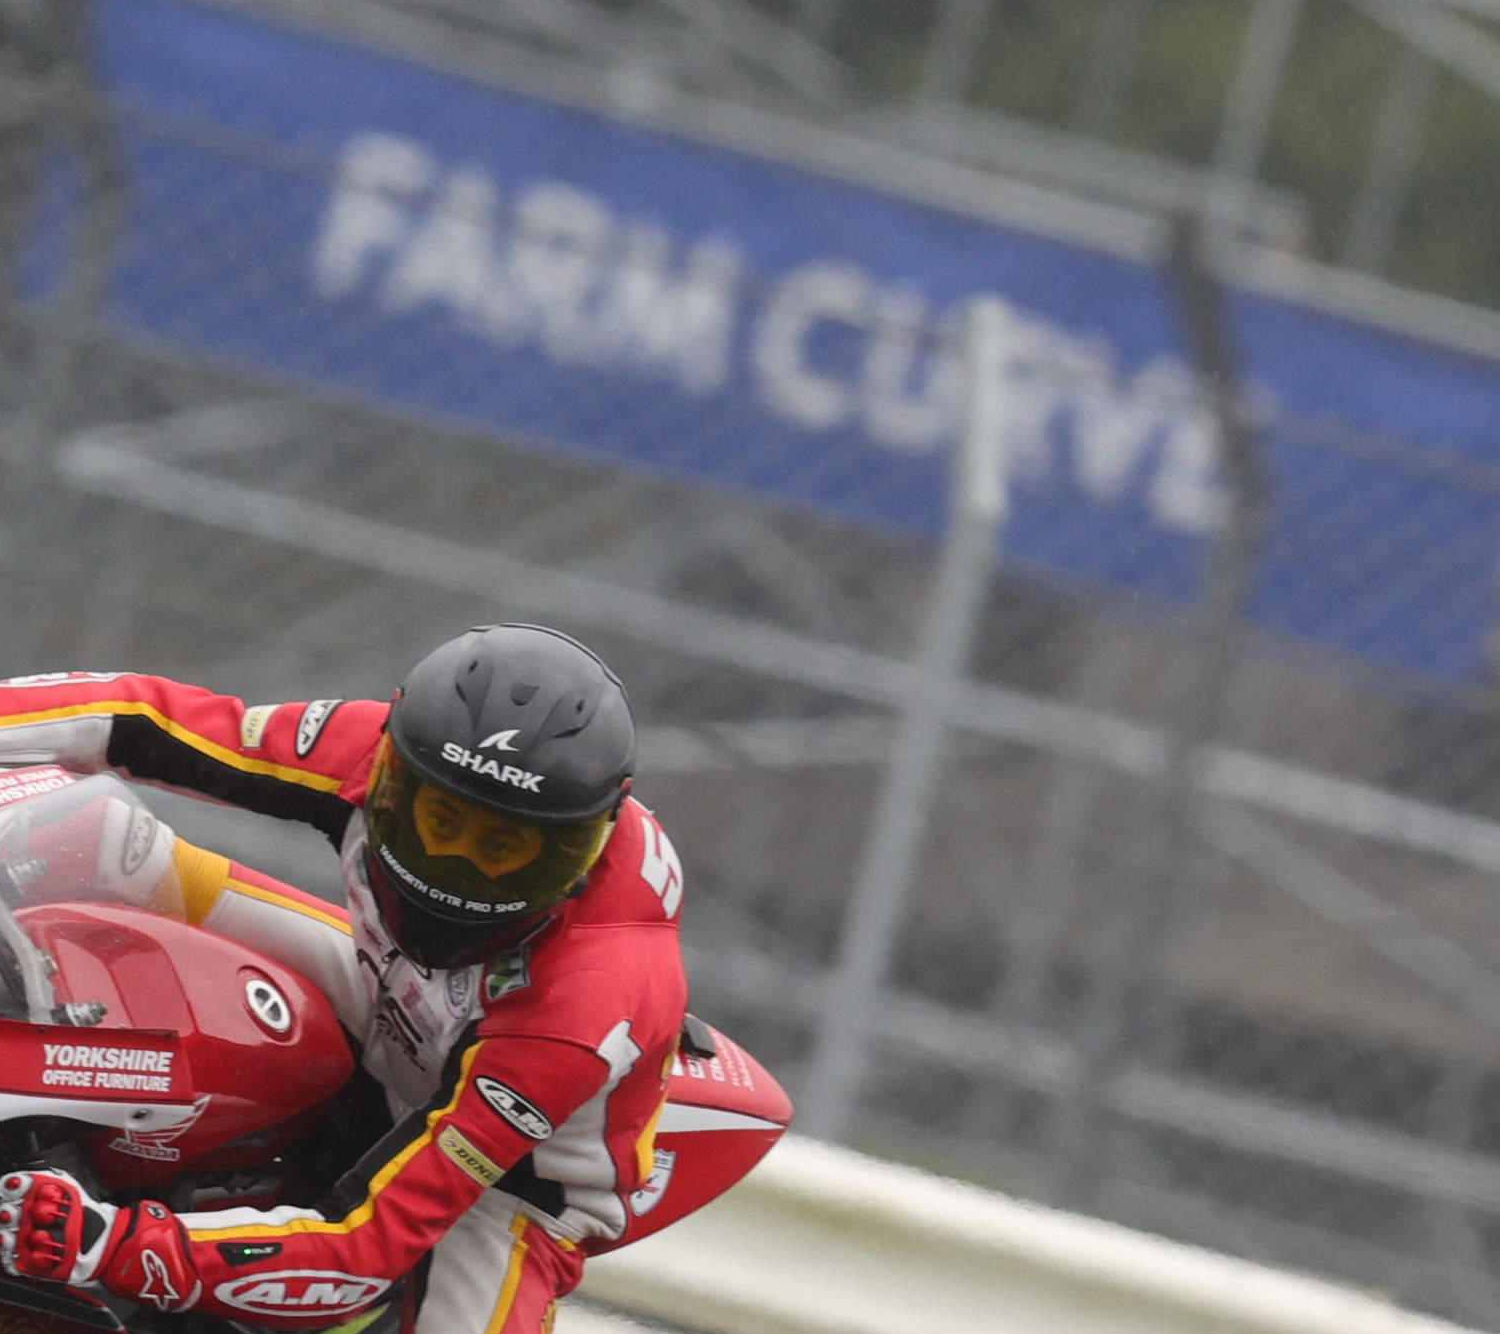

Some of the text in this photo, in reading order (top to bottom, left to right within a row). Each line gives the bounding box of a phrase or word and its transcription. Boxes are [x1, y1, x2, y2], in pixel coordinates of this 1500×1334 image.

[311, 131, 752, 400] FARM
[441, 741, 545, 794] SHARK
[379, 843, 528, 913] TAMWORTH GYTR PRO SHOP
[42, 1043, 174, 1073] YORKSHIRE
[42, 1069, 172, 1093] OFFICE FURNITURE
[454, 1147, 496, 1182] DUNL
